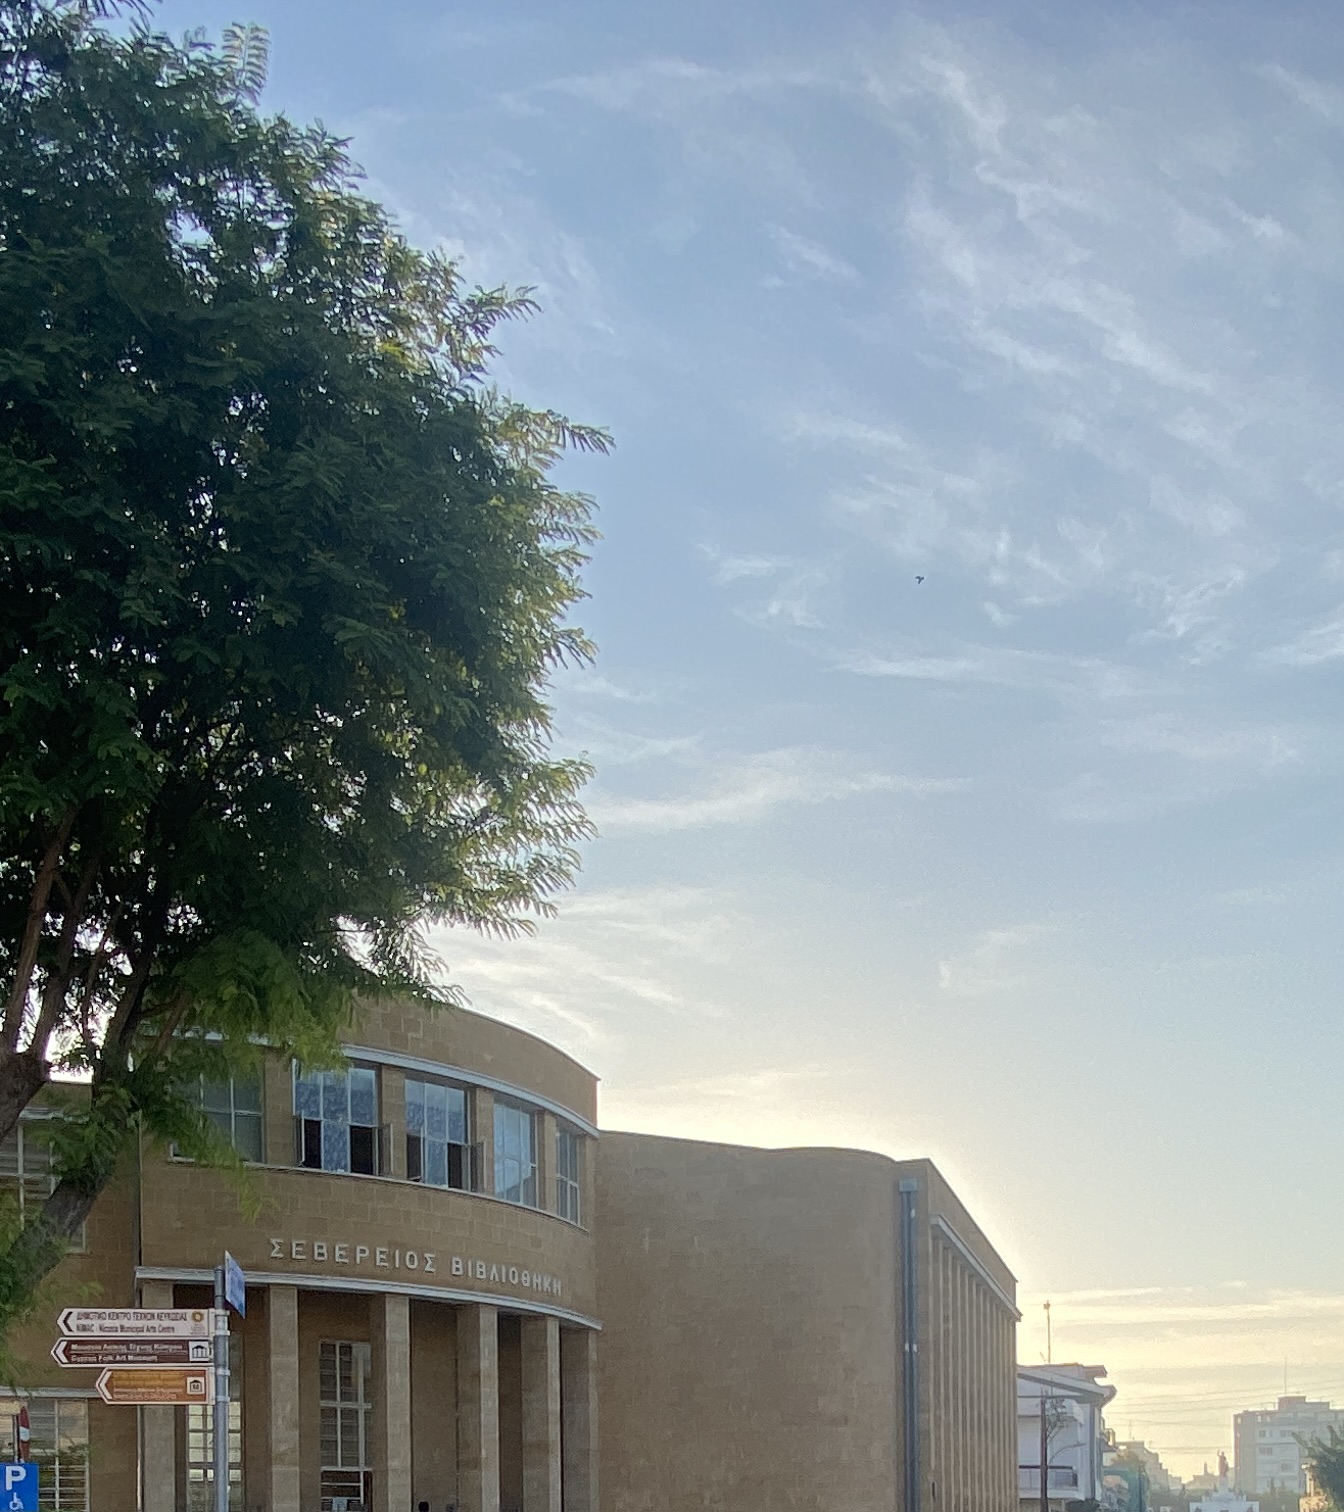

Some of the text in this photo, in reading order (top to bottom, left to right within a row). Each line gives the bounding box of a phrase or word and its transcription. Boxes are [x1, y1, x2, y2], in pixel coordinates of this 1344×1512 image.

[269, 1237, 563, 1297] ΣΕΒΕΡΕΙΟΣ ΒΙΒΛΙΟΘΗΚΗ
[5, 1465, 27, 1491] P
